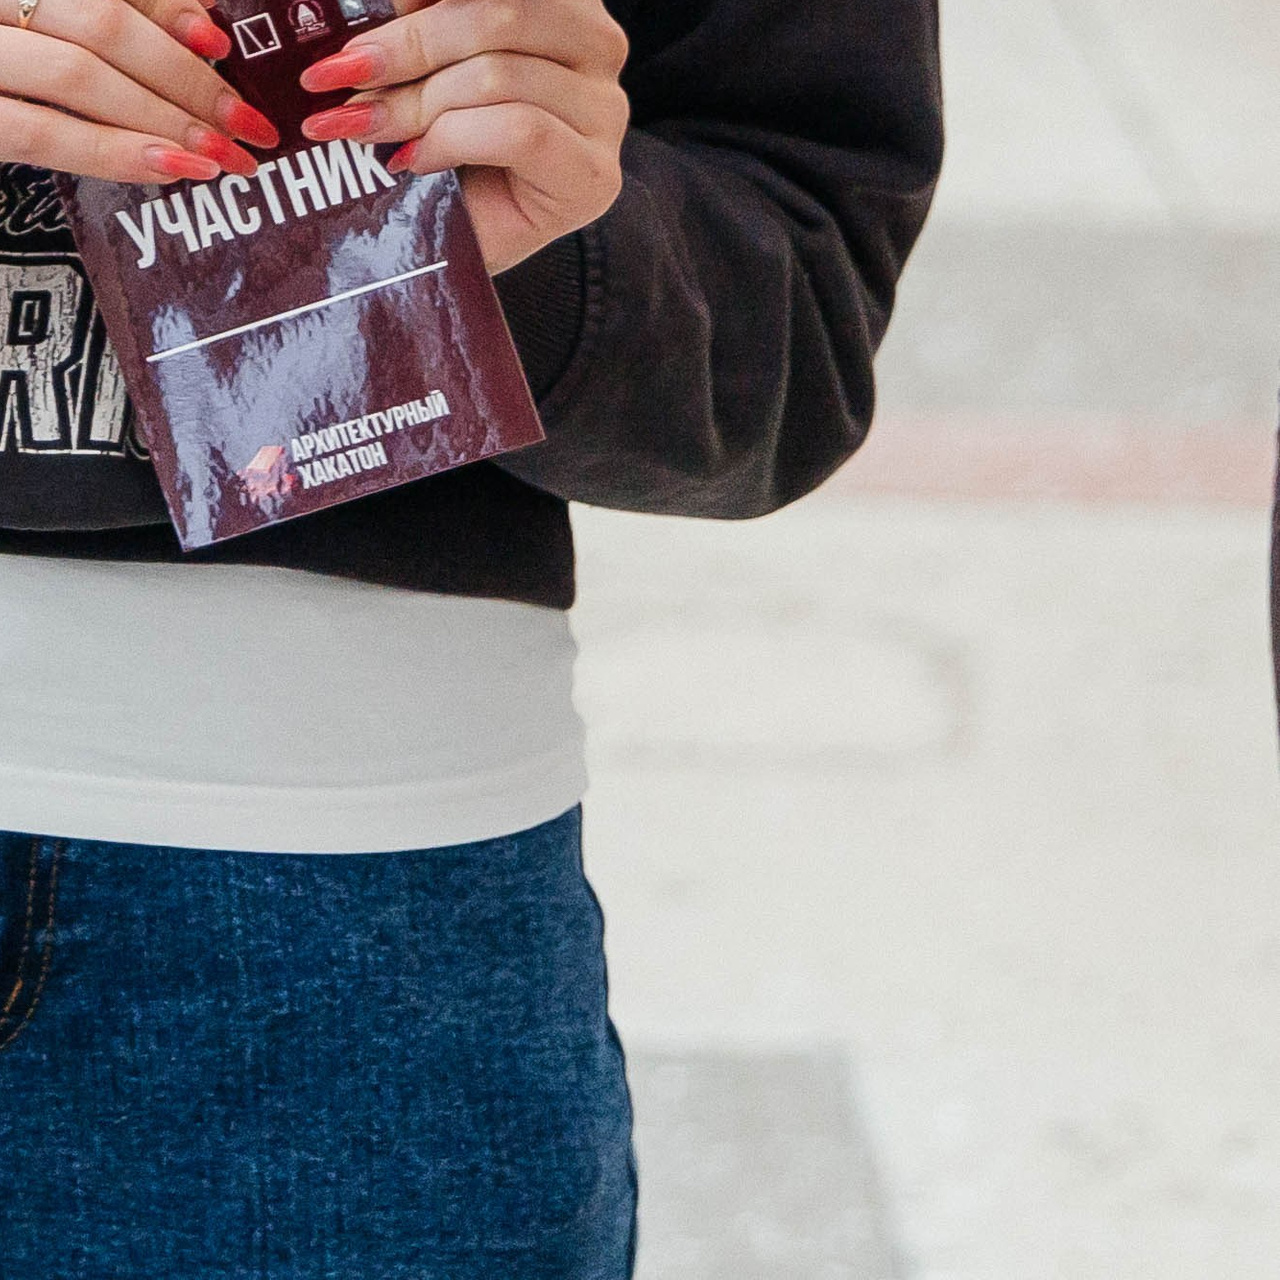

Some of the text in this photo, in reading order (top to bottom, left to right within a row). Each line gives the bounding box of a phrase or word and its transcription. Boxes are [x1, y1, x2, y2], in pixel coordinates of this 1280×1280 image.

[114, 138, 397, 270] УЧАСТНИК
[290, 389, 452, 463] АРХИТЕКТУРНЫЙ
[297, 441, 388, 490] ХАКАТОН
